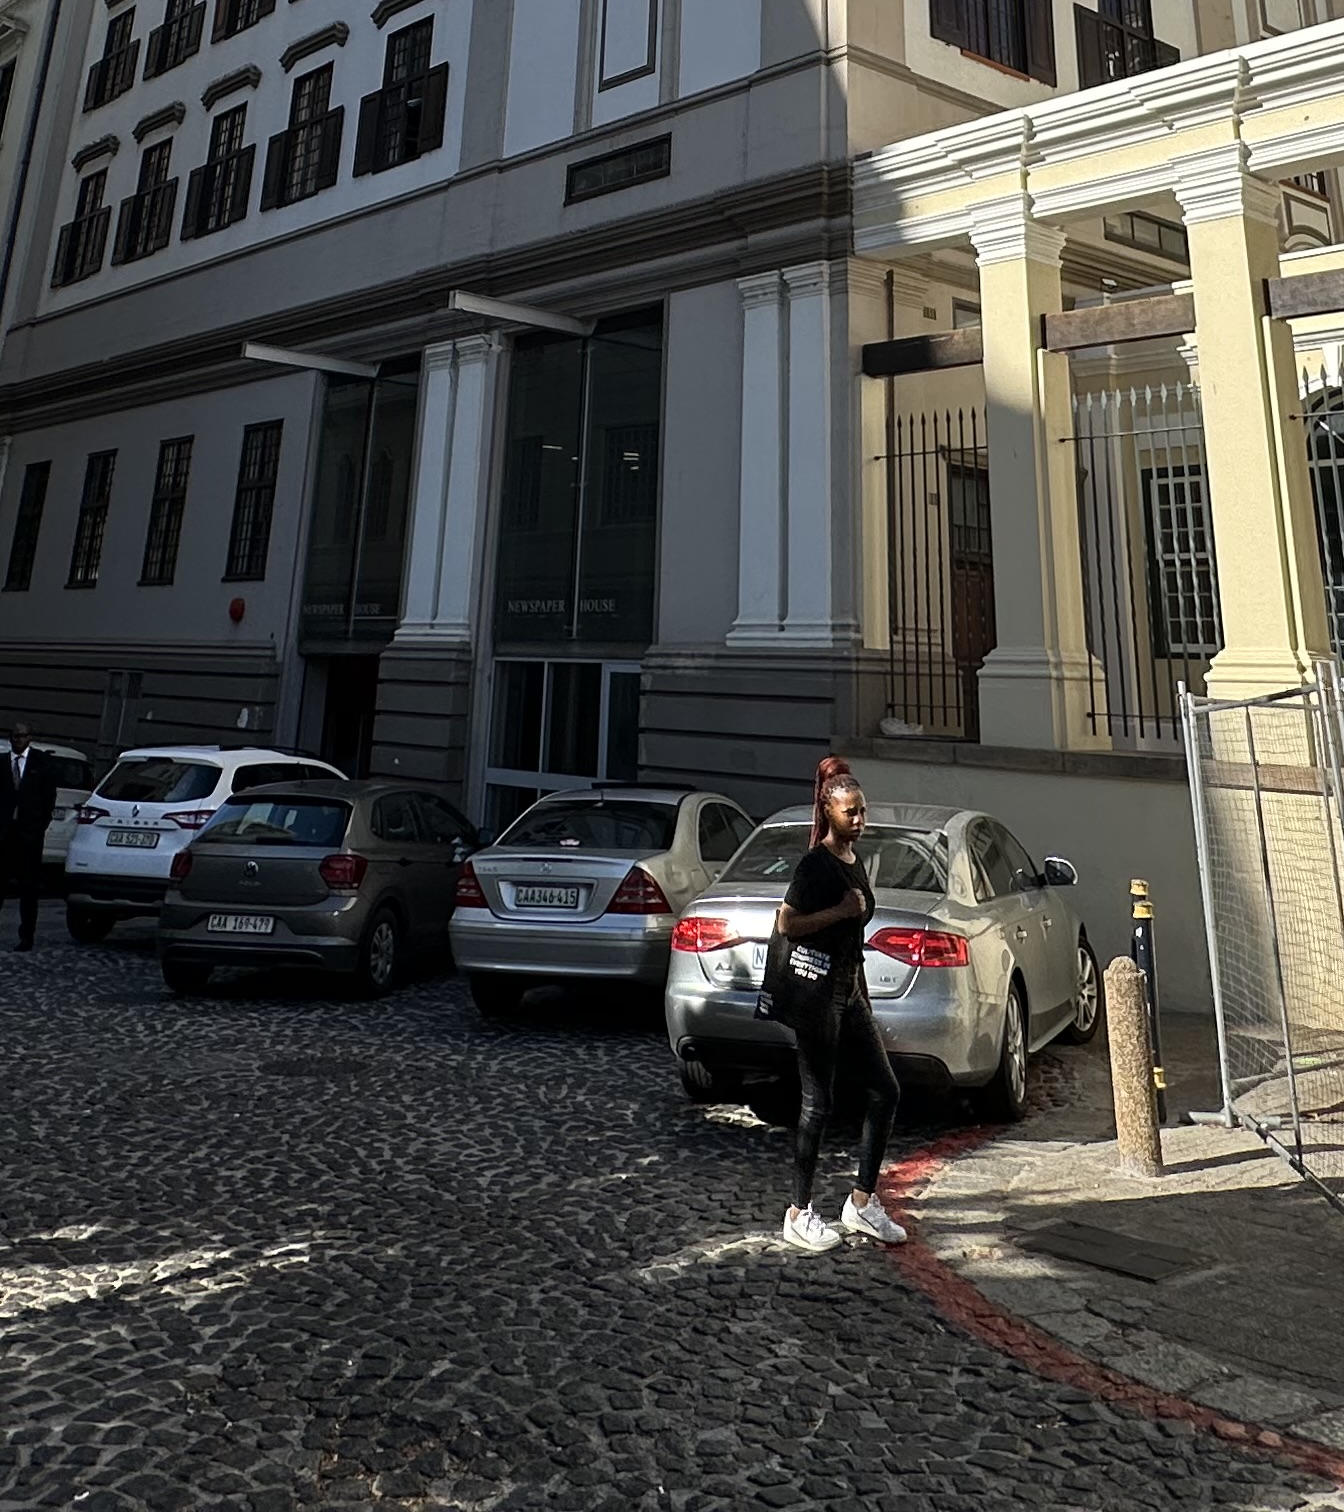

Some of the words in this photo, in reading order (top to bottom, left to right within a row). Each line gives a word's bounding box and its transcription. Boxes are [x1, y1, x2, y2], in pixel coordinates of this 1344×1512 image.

[302, 603, 345, 615] NEWSPAPER
[507, 599, 566, 613] NEWSPAPER
[580, 598, 616, 612] HOUSE
[211, 915, 227, 929] CAA
